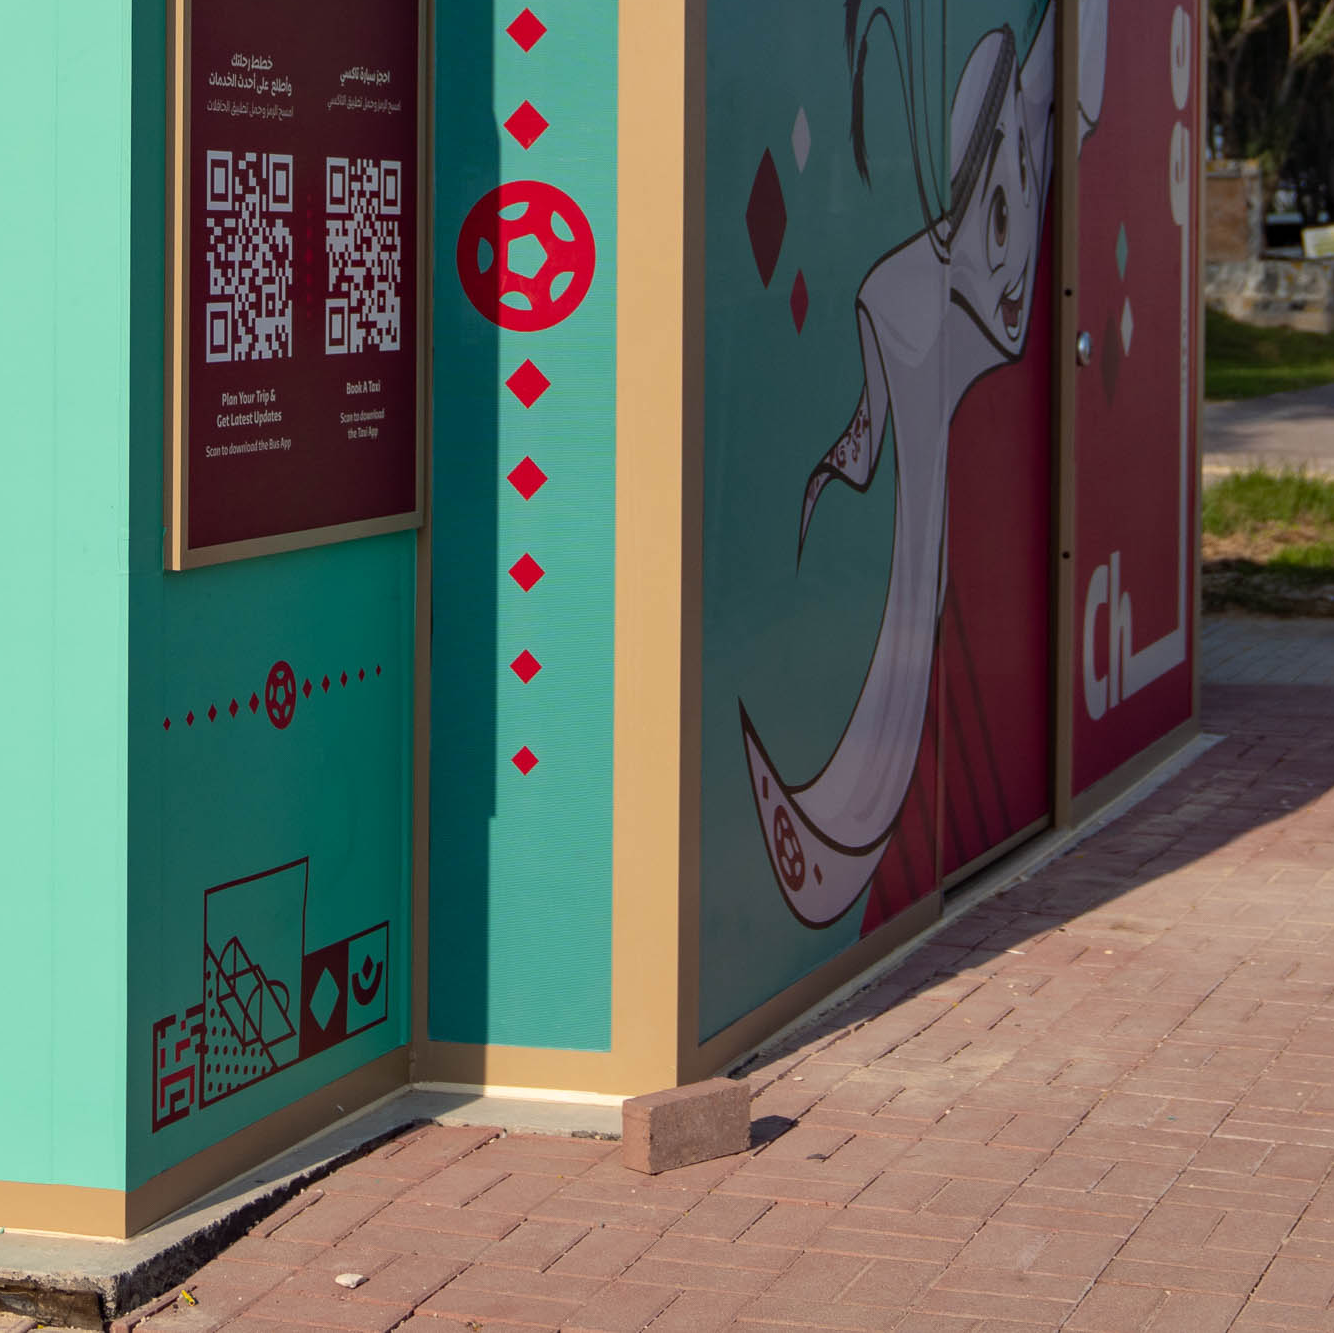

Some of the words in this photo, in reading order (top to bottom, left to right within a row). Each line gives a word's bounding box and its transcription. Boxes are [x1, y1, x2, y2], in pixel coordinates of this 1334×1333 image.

[346, 380, 362, 394] Book
[368, 379, 381, 393] Taxi
[222, 392, 238, 406] Plan
[238, 391, 255, 405] Your
[255, 389, 269, 406] Trip
[269, 388, 276, 402] &
[216, 414, 230, 427] Get
[230, 412, 253, 426] Latest
[253, 409, 283, 427] Updates
[205, 445, 221, 458] Scan
[221, 445, 229, 456] to
[228, 440, 258, 455] download
[258, 439, 269, 451] the
[269, 438, 280, 450] Bus
[280, 437, 292, 451] App
